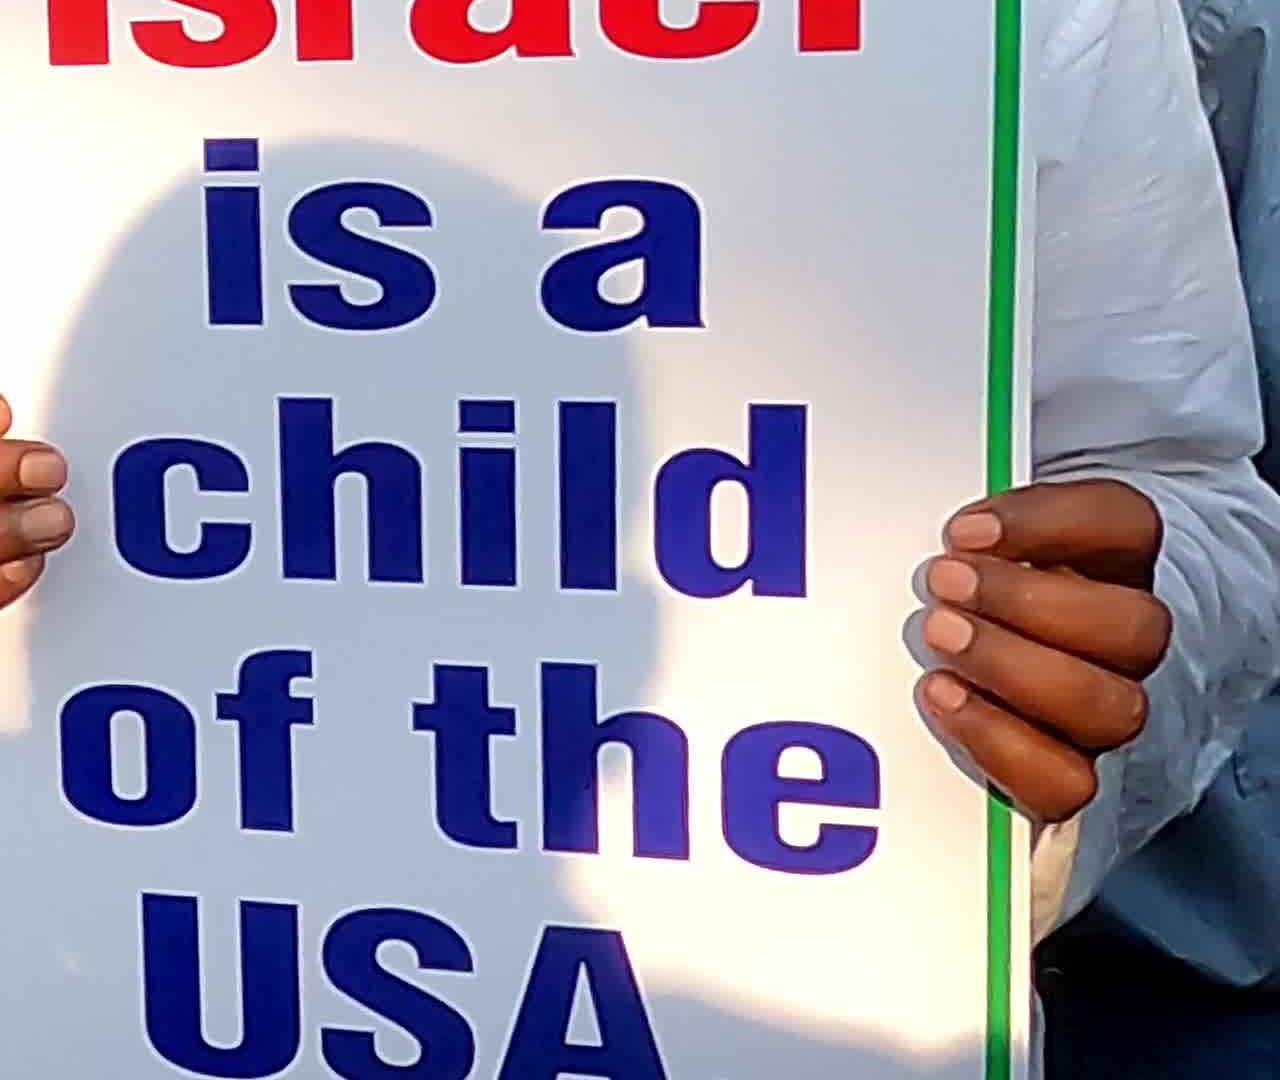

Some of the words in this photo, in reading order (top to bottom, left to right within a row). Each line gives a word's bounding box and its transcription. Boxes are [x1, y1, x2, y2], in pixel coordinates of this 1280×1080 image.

[203, 137, 436, 331] is
[539, 178, 706, 332] a
[112, 395, 808, 598] child
[59, 649, 315, 832] of
[411, 661, 881, 875] the
[141, 891, 668, 1080] USA
